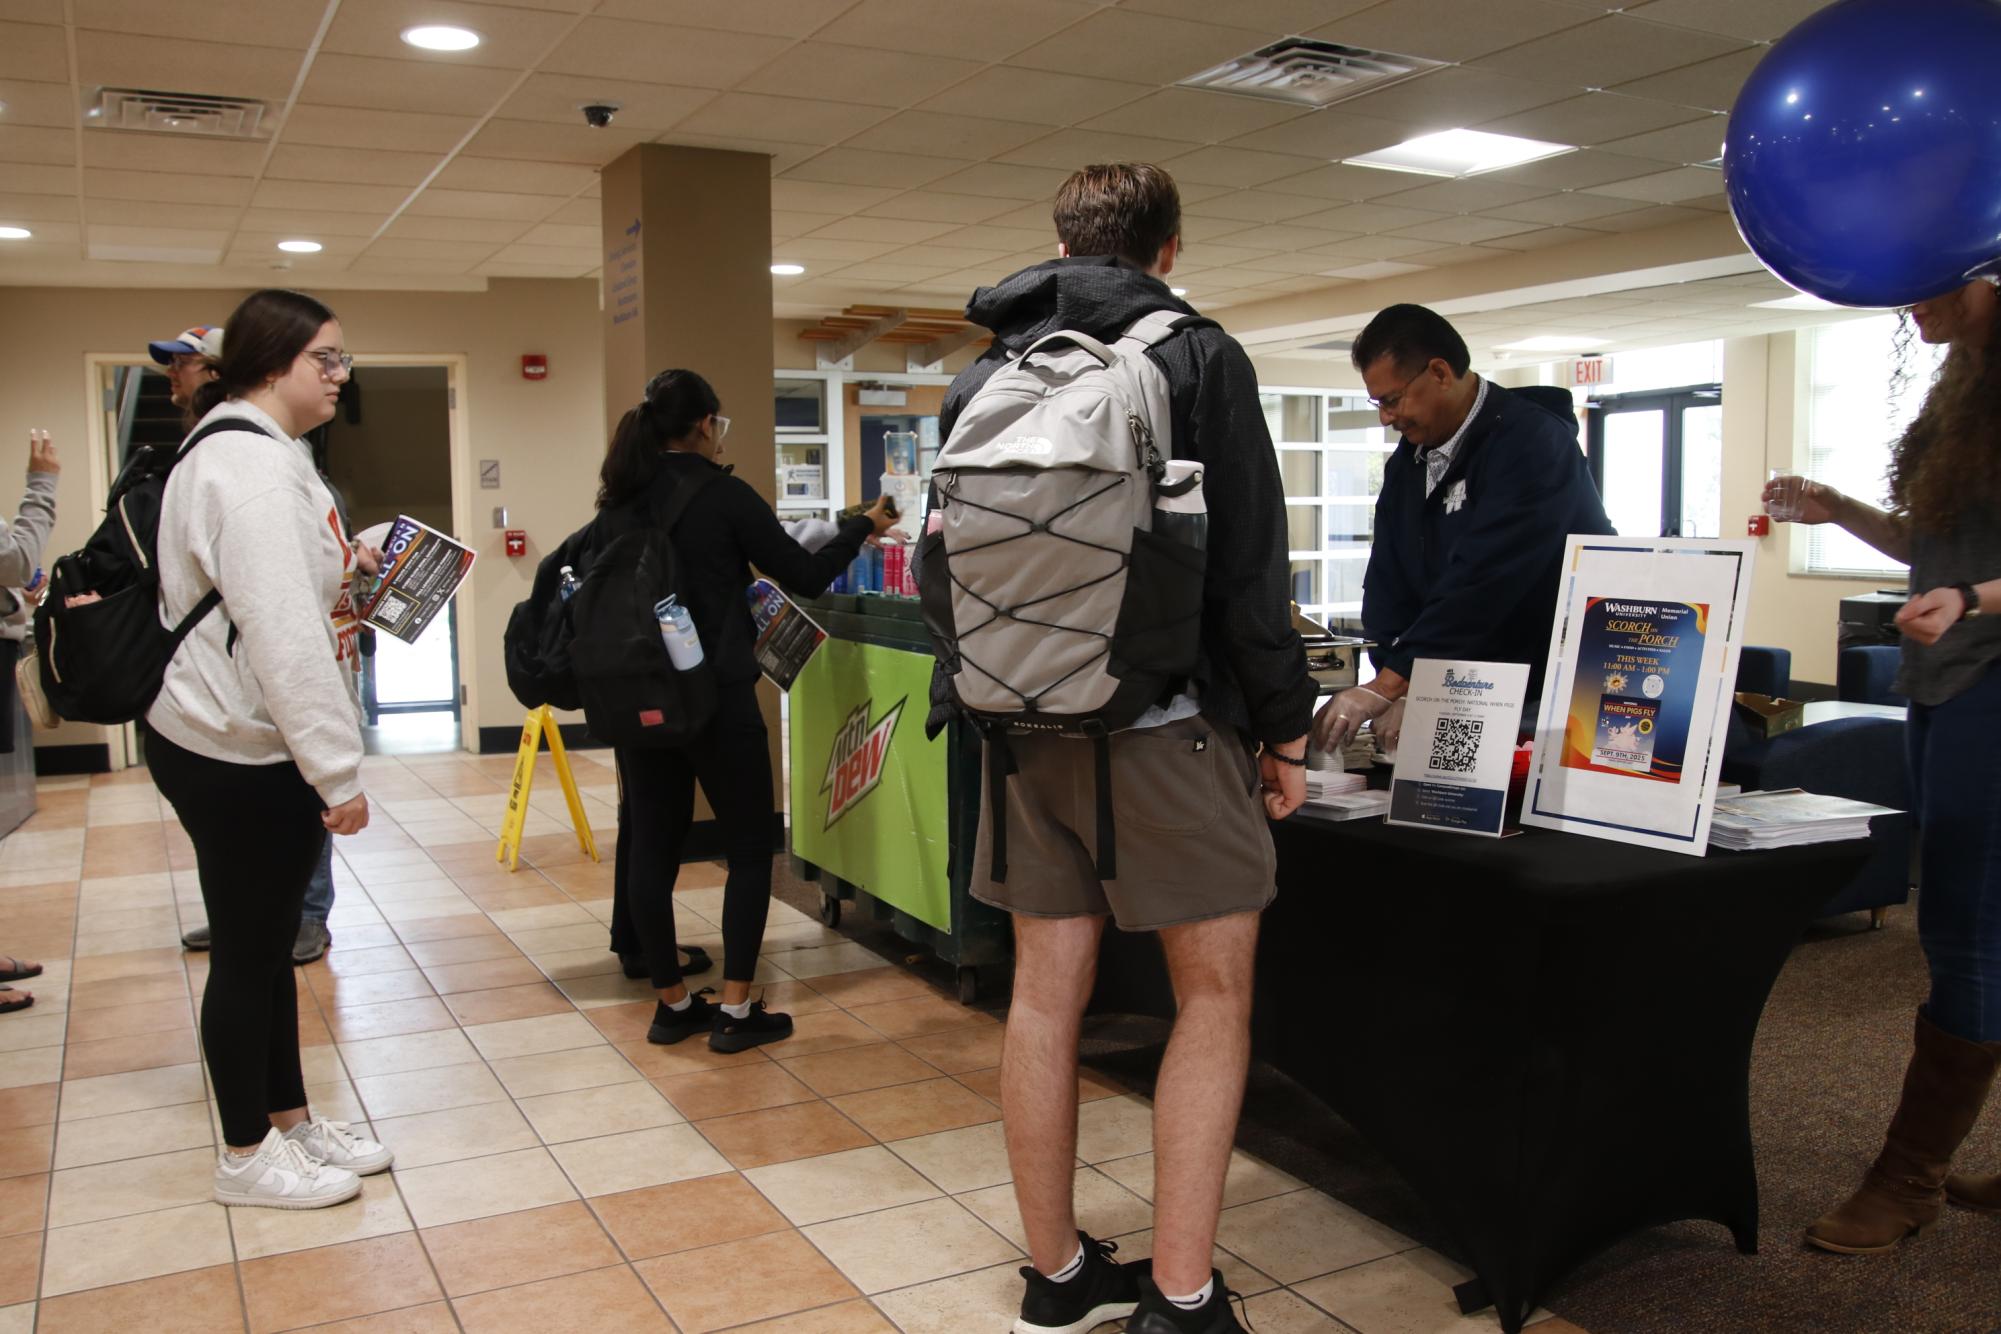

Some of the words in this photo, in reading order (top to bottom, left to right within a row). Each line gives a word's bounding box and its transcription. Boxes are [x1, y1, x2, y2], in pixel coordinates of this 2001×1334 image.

[1576, 360, 1602, 384] EXIT
[393, 526, 419, 554] ON
[767, 595, 785, 616] ON
[1605, 602, 1658, 614] WASHBURN
[1661, 607, 1689, 615] Memorial
[1607, 620, 1652, 632] SCORCH
[1640, 634, 1679, 647] PORCH
[1617, 655, 1635, 663] THIS
[1636, 657, 1660, 665] WEEK
[1603, 662, 1622, 670] 11:00
[1622, 664, 1636, 672] AM
[1449, 687, 1483, 696] CHECK-IN
[1604, 704, 1626, 713] WHEN
[1643, 709, 1656, 717] FLY
